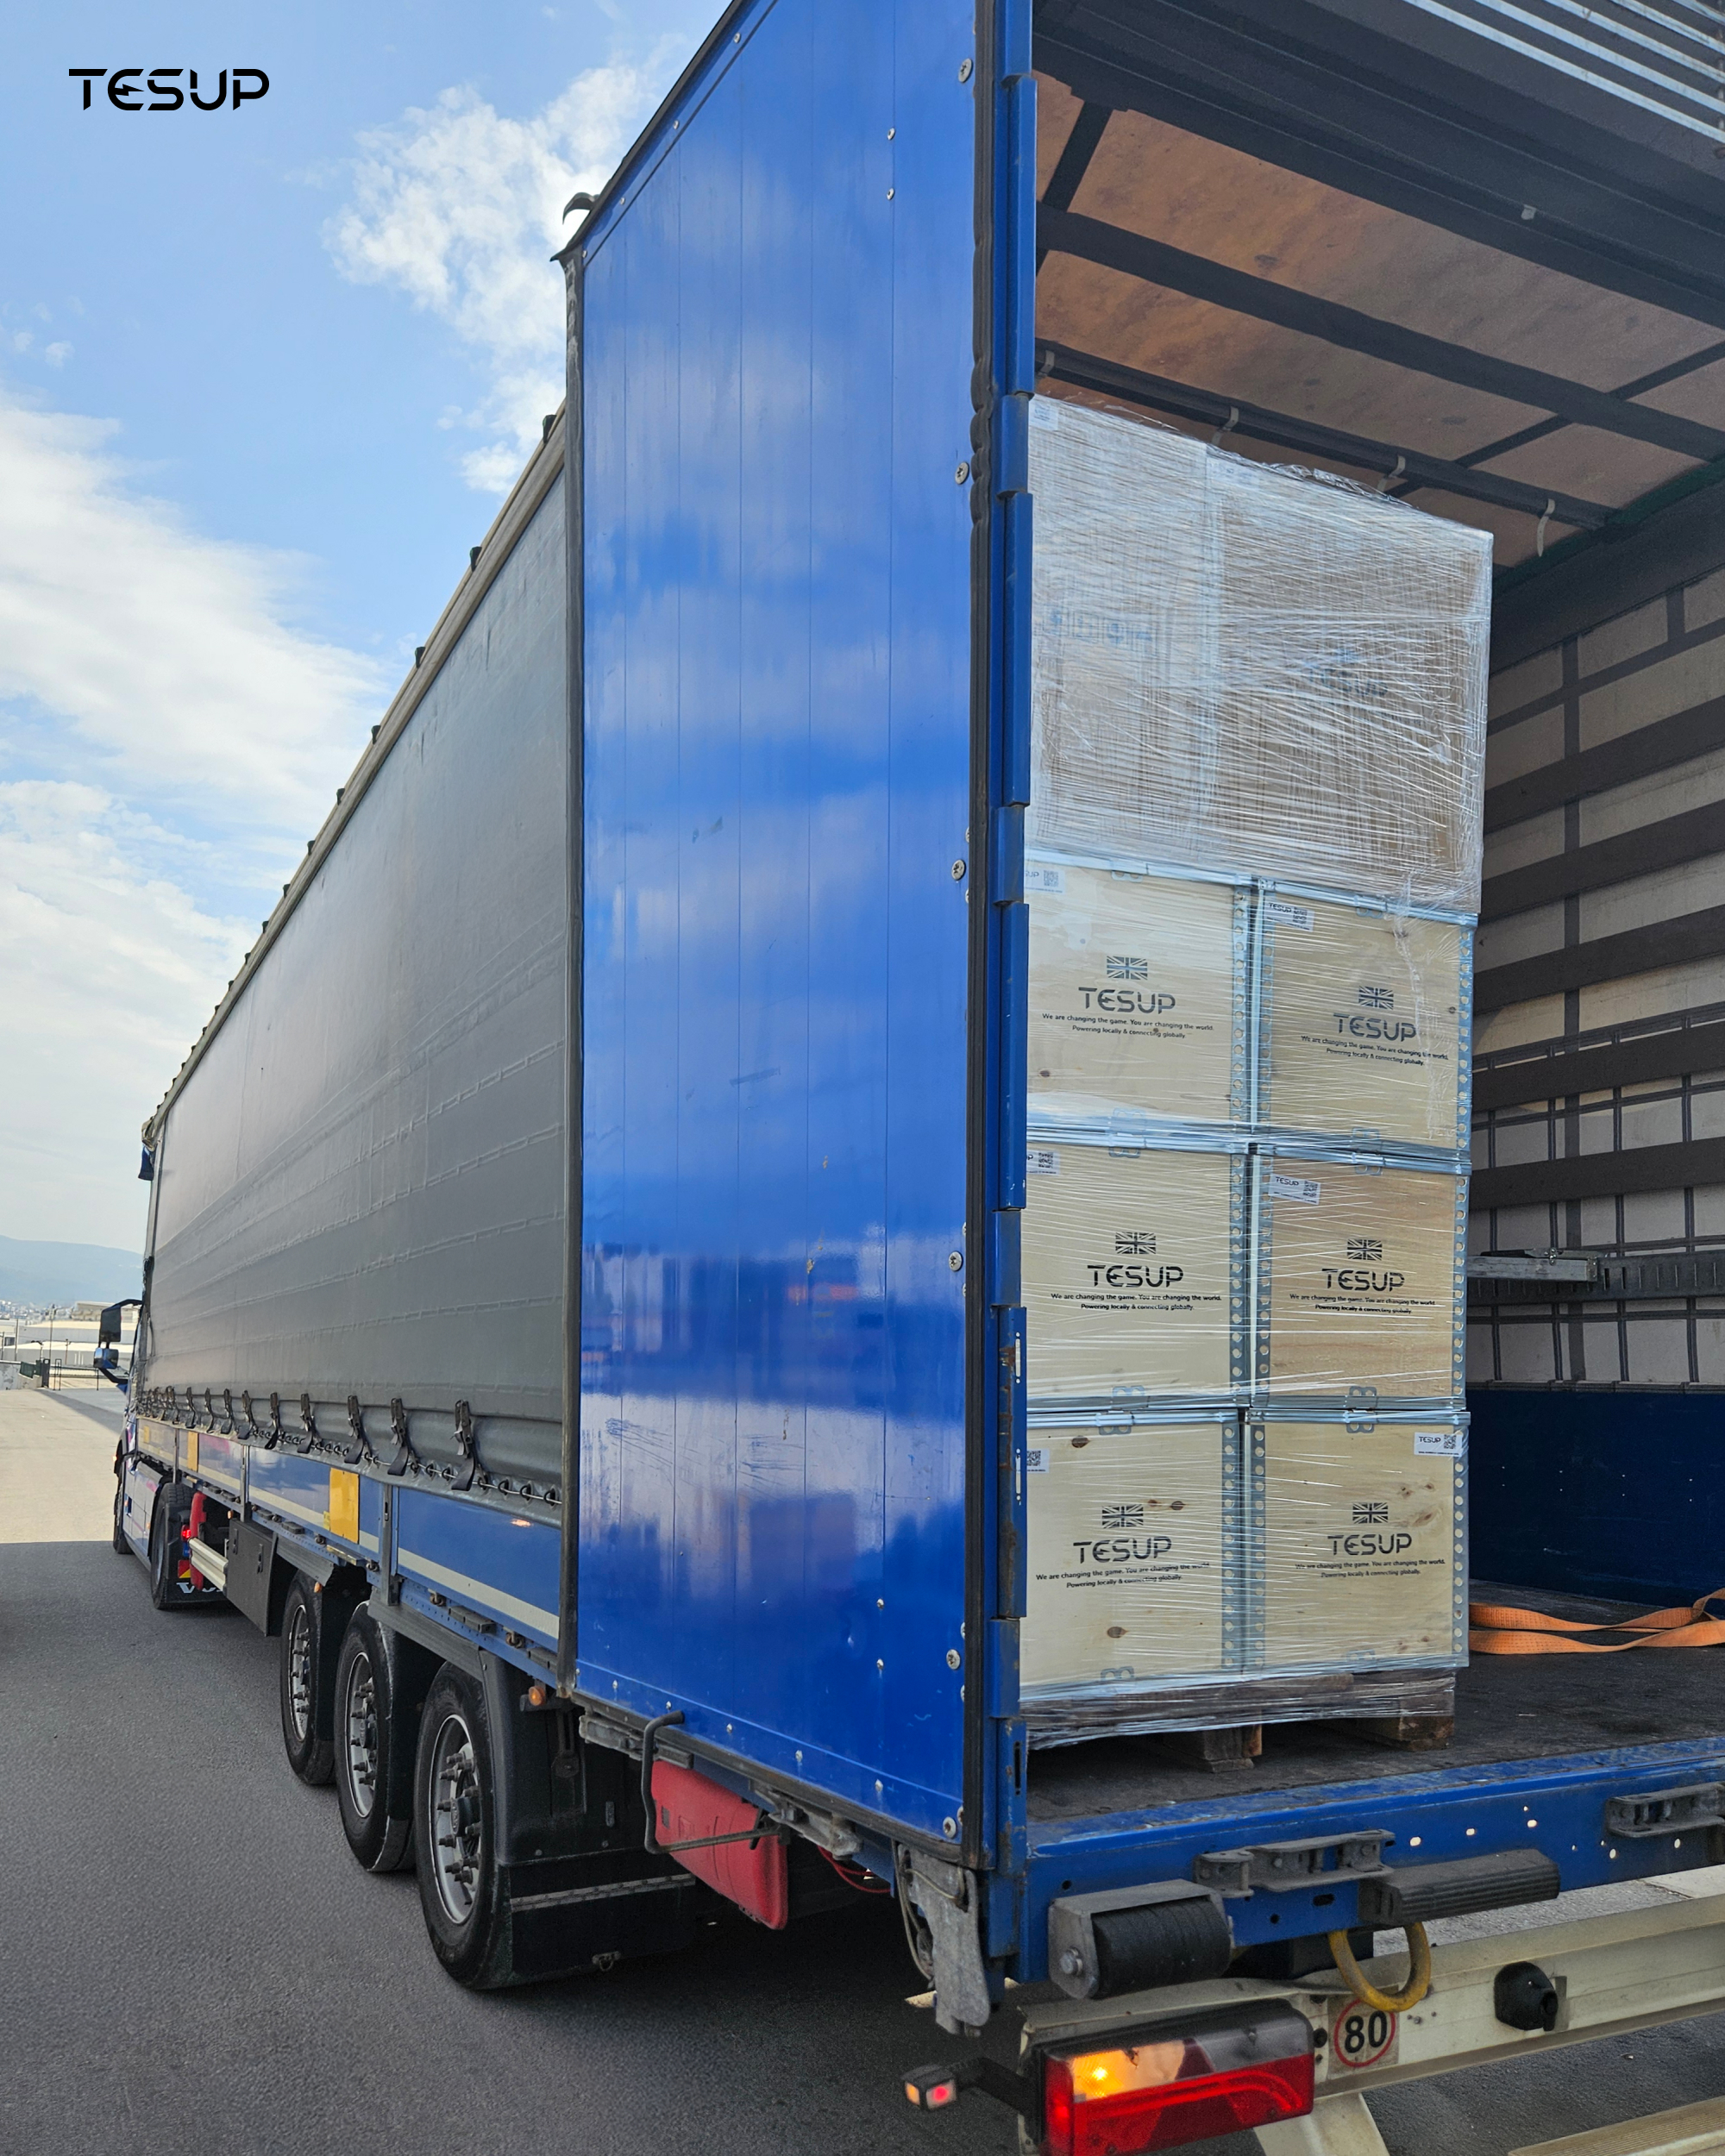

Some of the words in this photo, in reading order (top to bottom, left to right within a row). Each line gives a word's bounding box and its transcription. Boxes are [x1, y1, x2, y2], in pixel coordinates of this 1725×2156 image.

[1268, 902, 1292, 913] TESUP
[1078, 987, 1176, 1015] TESUP
[1067, 1014, 1096, 1024] changing
[1072, 1025, 1101, 1033] Powering
[1129, 1029, 1161, 1037] connecting
[1333, 1012, 1417, 1043] TESUP
[1322, 1038, 1347, 1047] changing
[1397, 1049, 1421, 1057] changing
[1375, 1055, 1403, 1063] connecting
[1275, 1176, 1300, 1187] TESUP
[1087, 1264, 1184, 1288] TESUP
[1321, 1268, 1406, 1292] TESUP
[1072, 1536, 1172, 1564] TESUP
[1327, 1532, 1413, 1556] TESUP
[1345, 2010, 1388, 2053] 80
